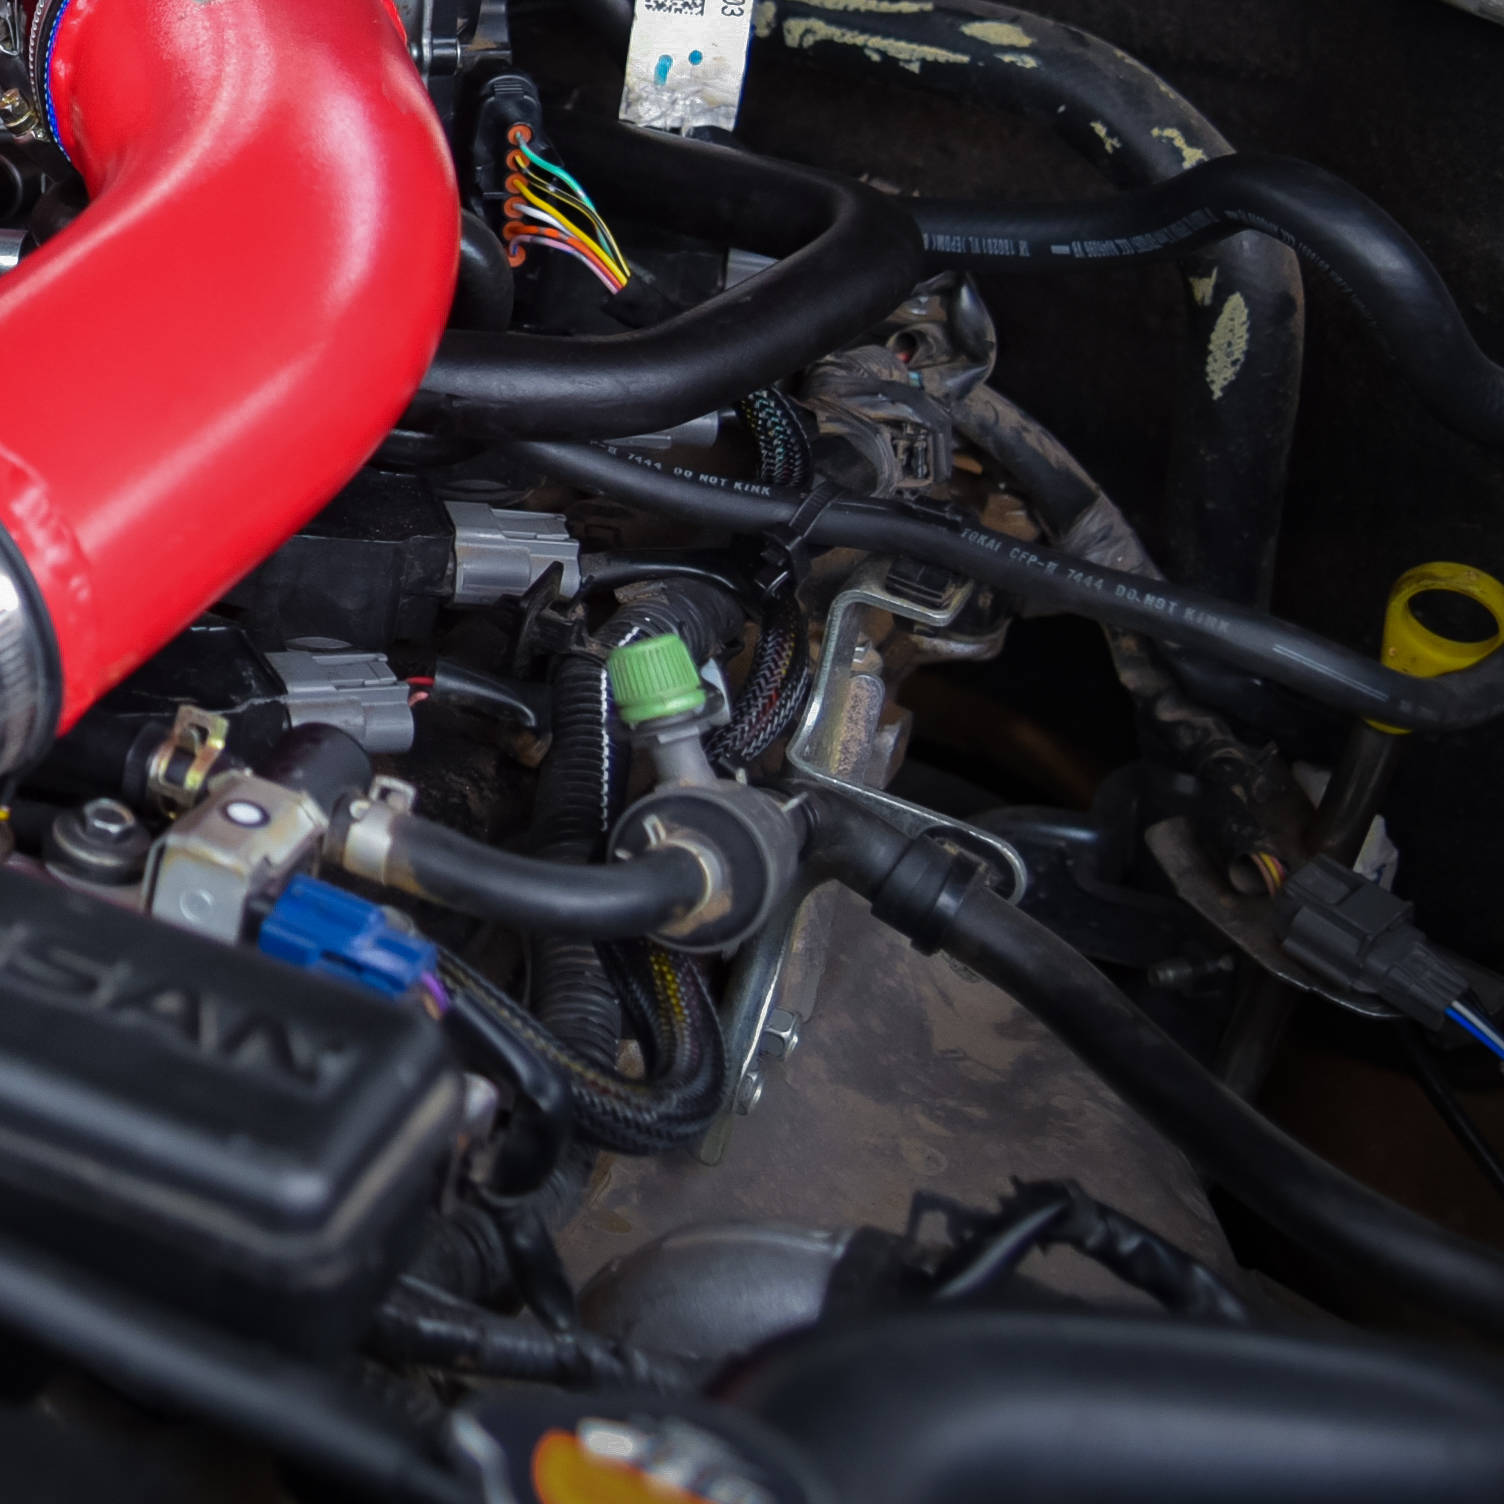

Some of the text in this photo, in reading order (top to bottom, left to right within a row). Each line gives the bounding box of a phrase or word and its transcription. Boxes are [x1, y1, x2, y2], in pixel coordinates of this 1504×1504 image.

[673, 466, 693, 479] DO
[698, 473, 728, 488] NOT
[733, 480, 772, 497] KINK
[960, 527, 1002, 554] TOKAI
[1066, 567, 1105, 592] 7444
[1144, 594, 1179, 617] NOT
